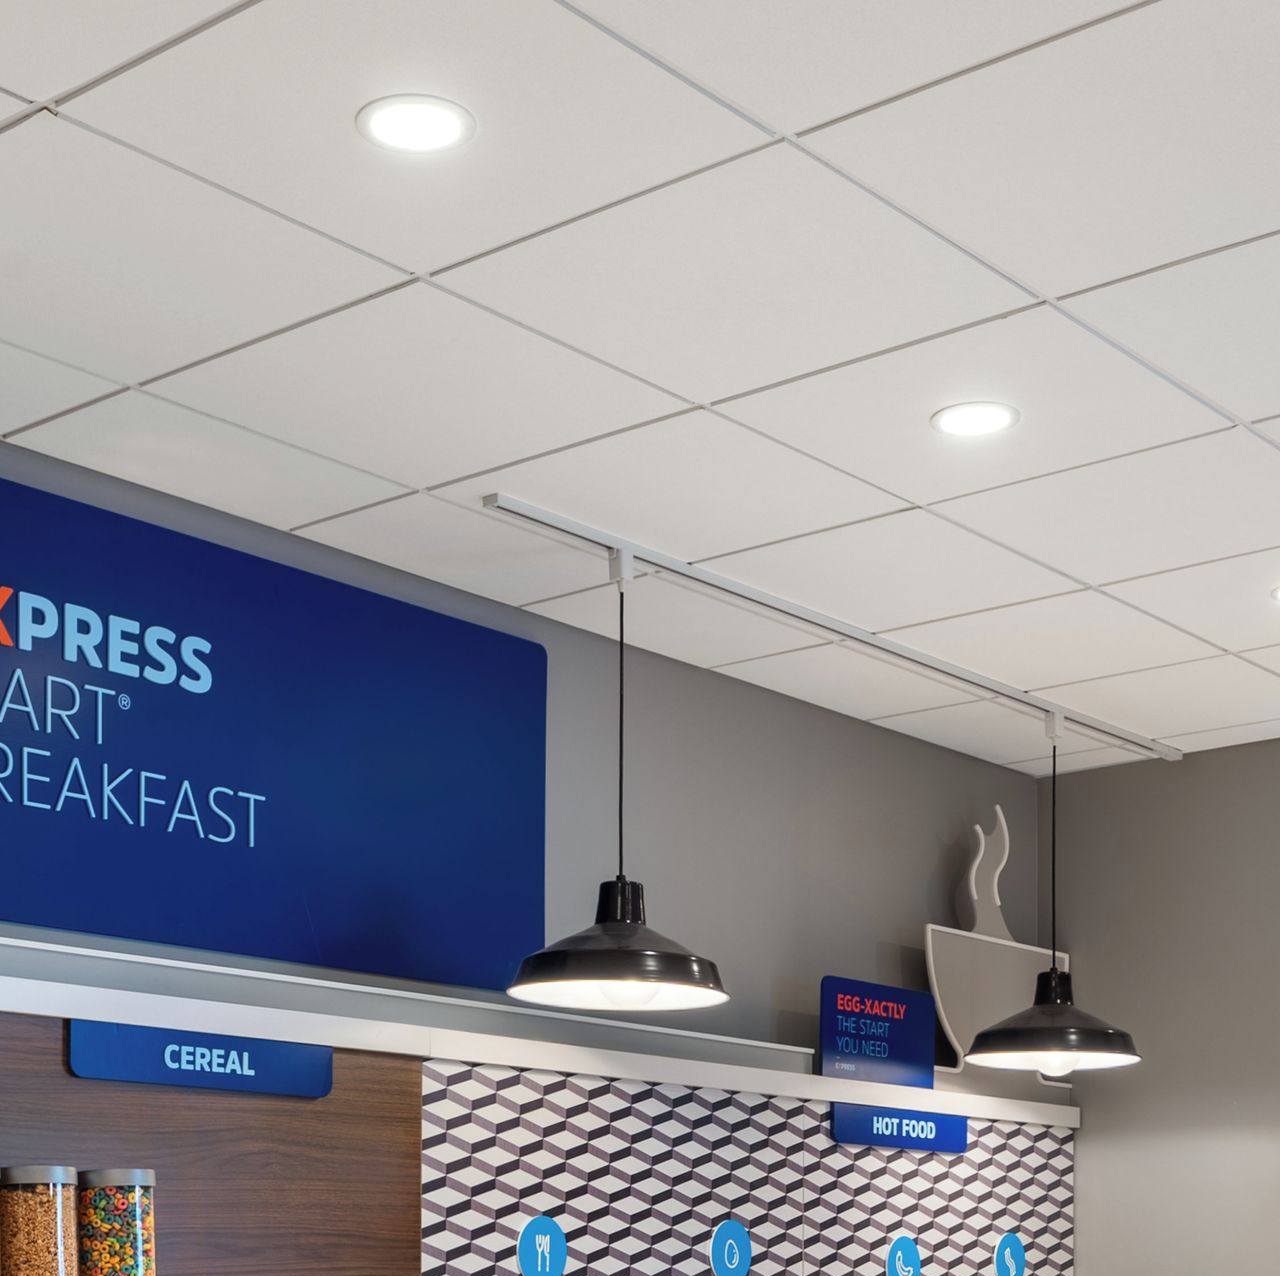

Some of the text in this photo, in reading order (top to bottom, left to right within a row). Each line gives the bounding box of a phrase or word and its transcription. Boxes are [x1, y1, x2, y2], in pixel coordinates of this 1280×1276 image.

[836, 993, 907, 1020] EGG-XACTLY
[836, 1015, 890, 1038] THE START
[836, 1036, 889, 1058] YOU NEED
[163, 1043, 256, 1076] CEREAL
[872, 1116, 937, 1139] HOT FOOD
